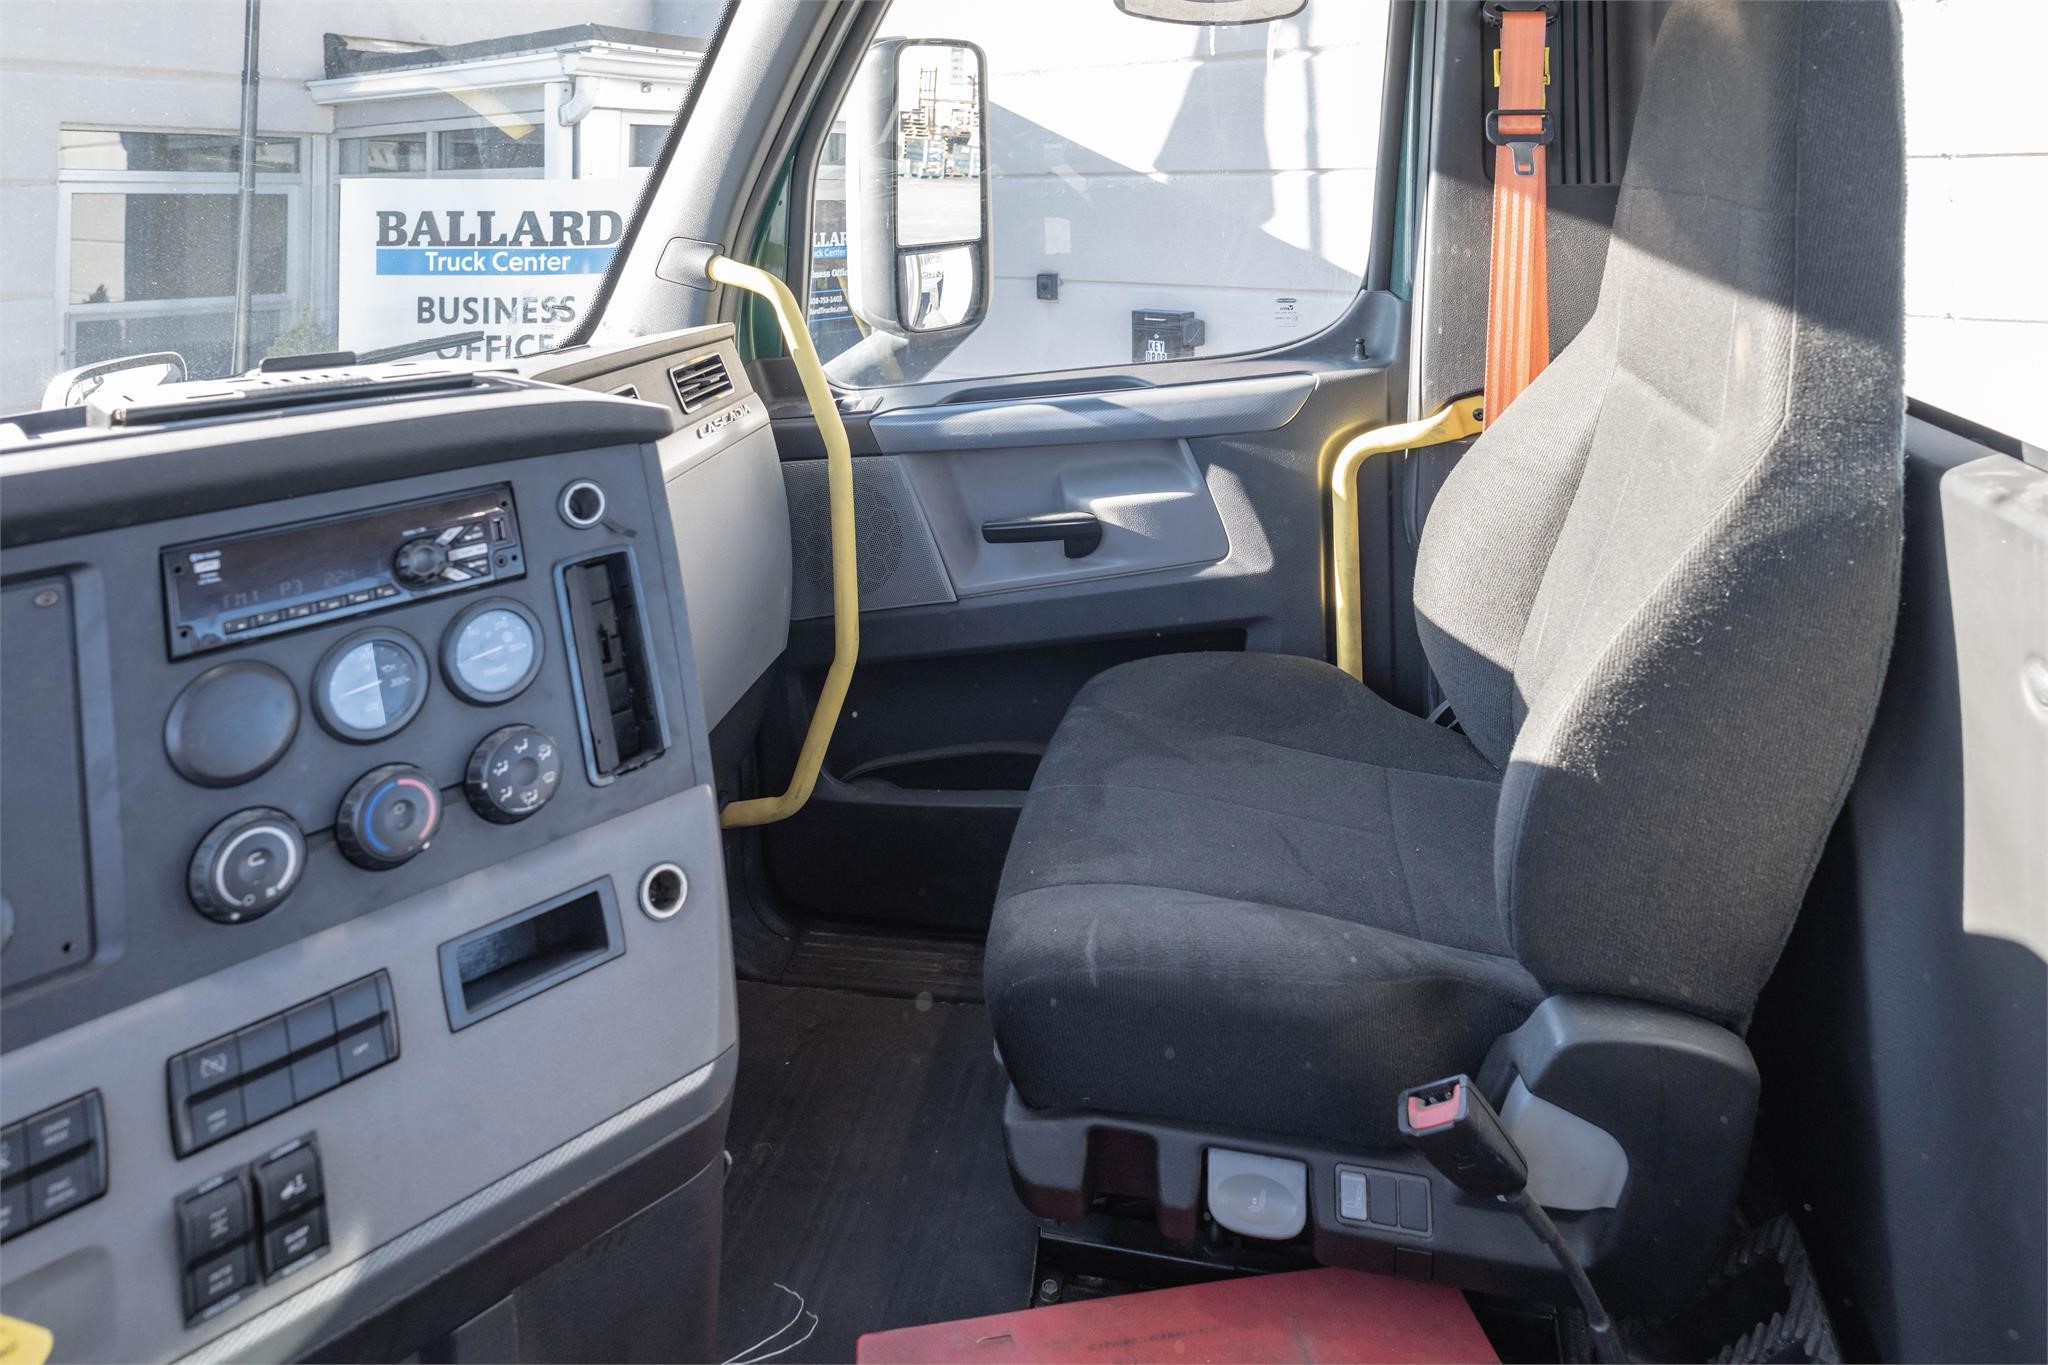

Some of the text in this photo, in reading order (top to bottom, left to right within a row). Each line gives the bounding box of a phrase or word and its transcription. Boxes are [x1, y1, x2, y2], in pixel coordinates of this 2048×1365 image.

[376, 210, 623, 247] BALLARD
[425, 251, 571, 272] Truck Center
[417, 295, 575, 325] BUSINESS
[1146, 351, 1166, 361] DROP
[1149, 340, 1164, 352] KEY
[697, 403, 752, 439] CASCADIA
